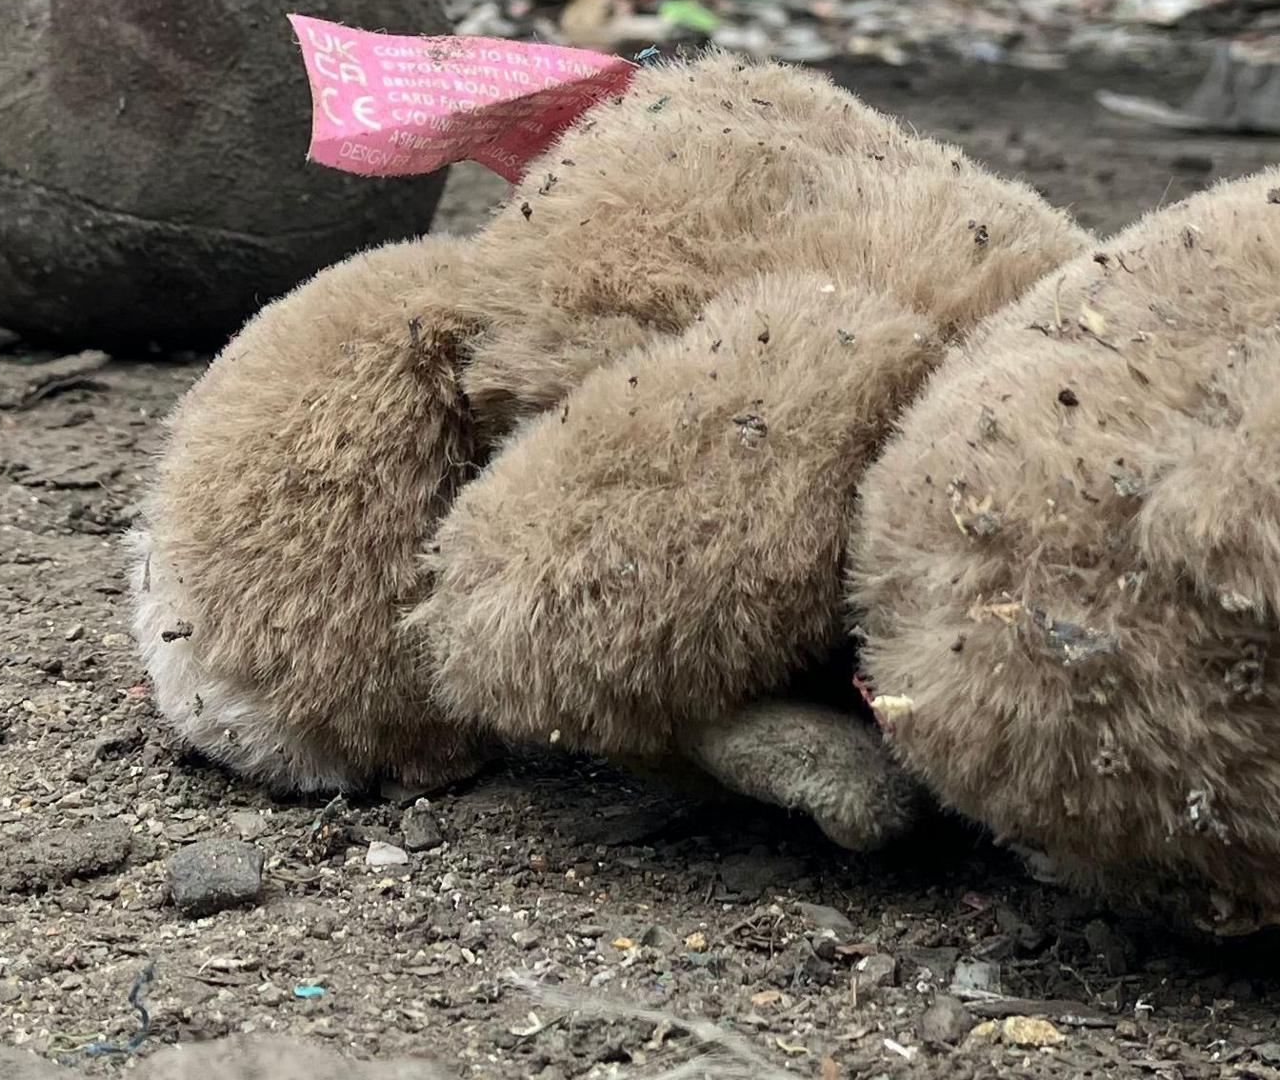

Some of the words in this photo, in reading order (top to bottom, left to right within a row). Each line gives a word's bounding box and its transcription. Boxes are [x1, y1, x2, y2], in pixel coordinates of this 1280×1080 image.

[307, 27, 361, 64] UK
[480, 49, 501, 62] TO
[314, 51, 368, 87] CA
[321, 87, 382, 131] CE
[387, 91, 435, 106] CARD
[339, 141, 393, 167] DESIGN
